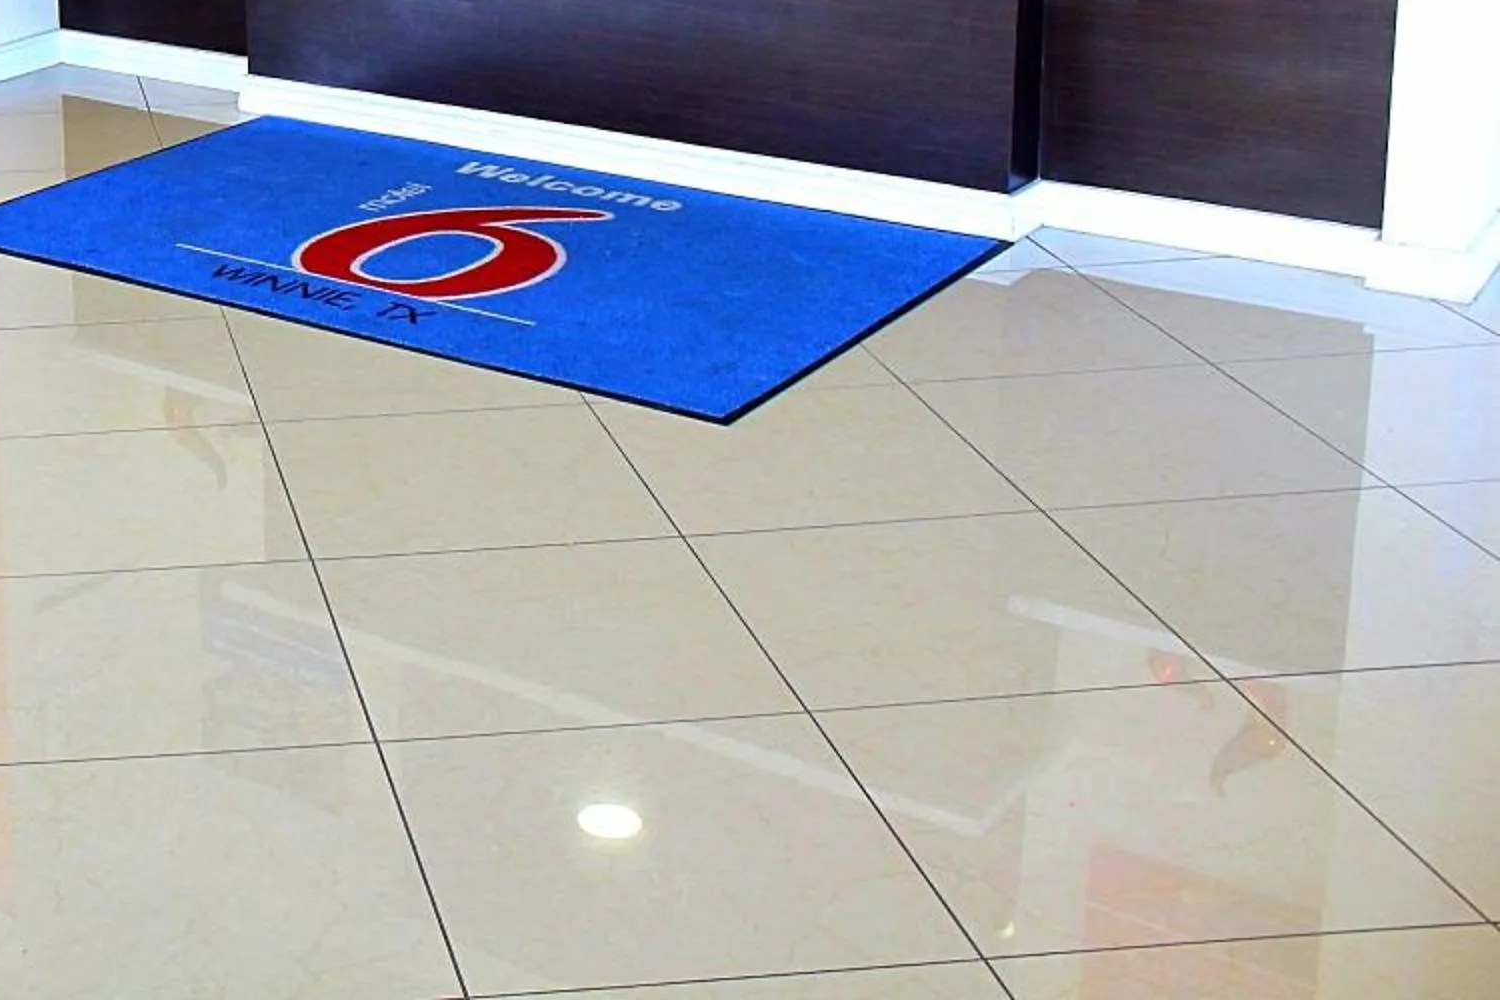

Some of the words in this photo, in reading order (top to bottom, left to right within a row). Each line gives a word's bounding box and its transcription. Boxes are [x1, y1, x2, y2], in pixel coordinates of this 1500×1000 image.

[454, 160, 684, 212] Welcome
[292, 206, 614, 300] 6
[376, 300, 437, 324] TX
